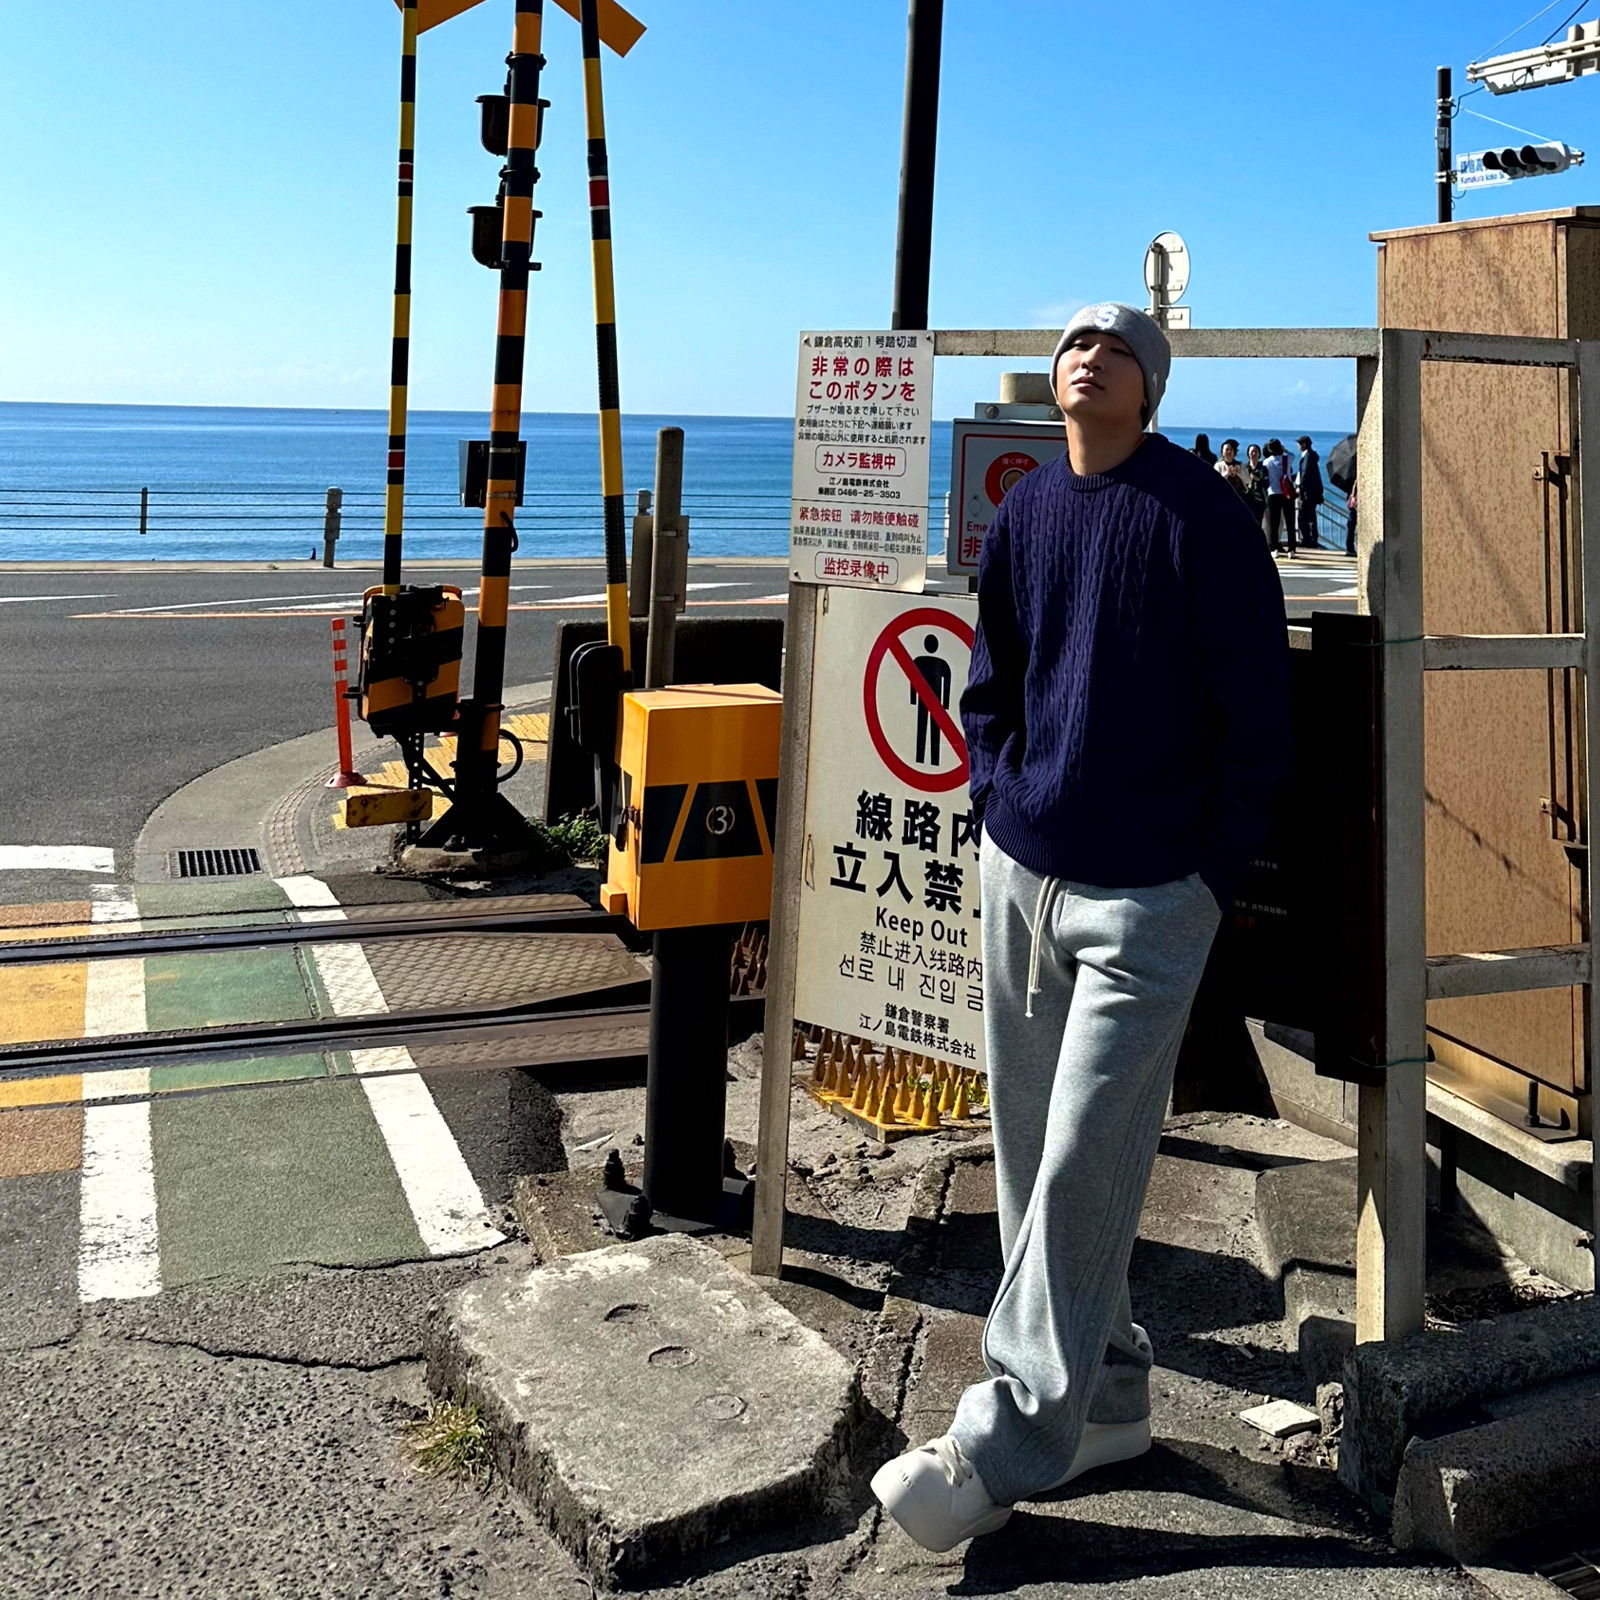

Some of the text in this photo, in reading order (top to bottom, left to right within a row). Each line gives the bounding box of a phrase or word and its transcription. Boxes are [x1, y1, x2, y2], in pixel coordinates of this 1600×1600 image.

[811, 356, 914, 377] 非常の際は
[809, 380, 916, 401] このボタンを
[807, 404, 920, 416] ブザーが鳴るまで押して下さい
[823, 452, 896, 470] カメラ監視中
[799, 506, 842, 522] 紧急按钮
[966, 521, 988, 532] Eme
[963, 536, 982, 558] 非
[823, 557, 889, 579] 监控录像中
[856, 789, 980, 858] 線路内
[830, 842, 981, 919] 立入禁
[875, 906, 968, 947] Keep Out
[860, 930, 983, 982] 禁止进入线路内
[838, 954, 984, 1012] 선로 내 진입 금
[884, 1002, 950, 1034] 鎌倉警察署
[859, 1013, 976, 1060] 江ノ島電鉄株式会社
